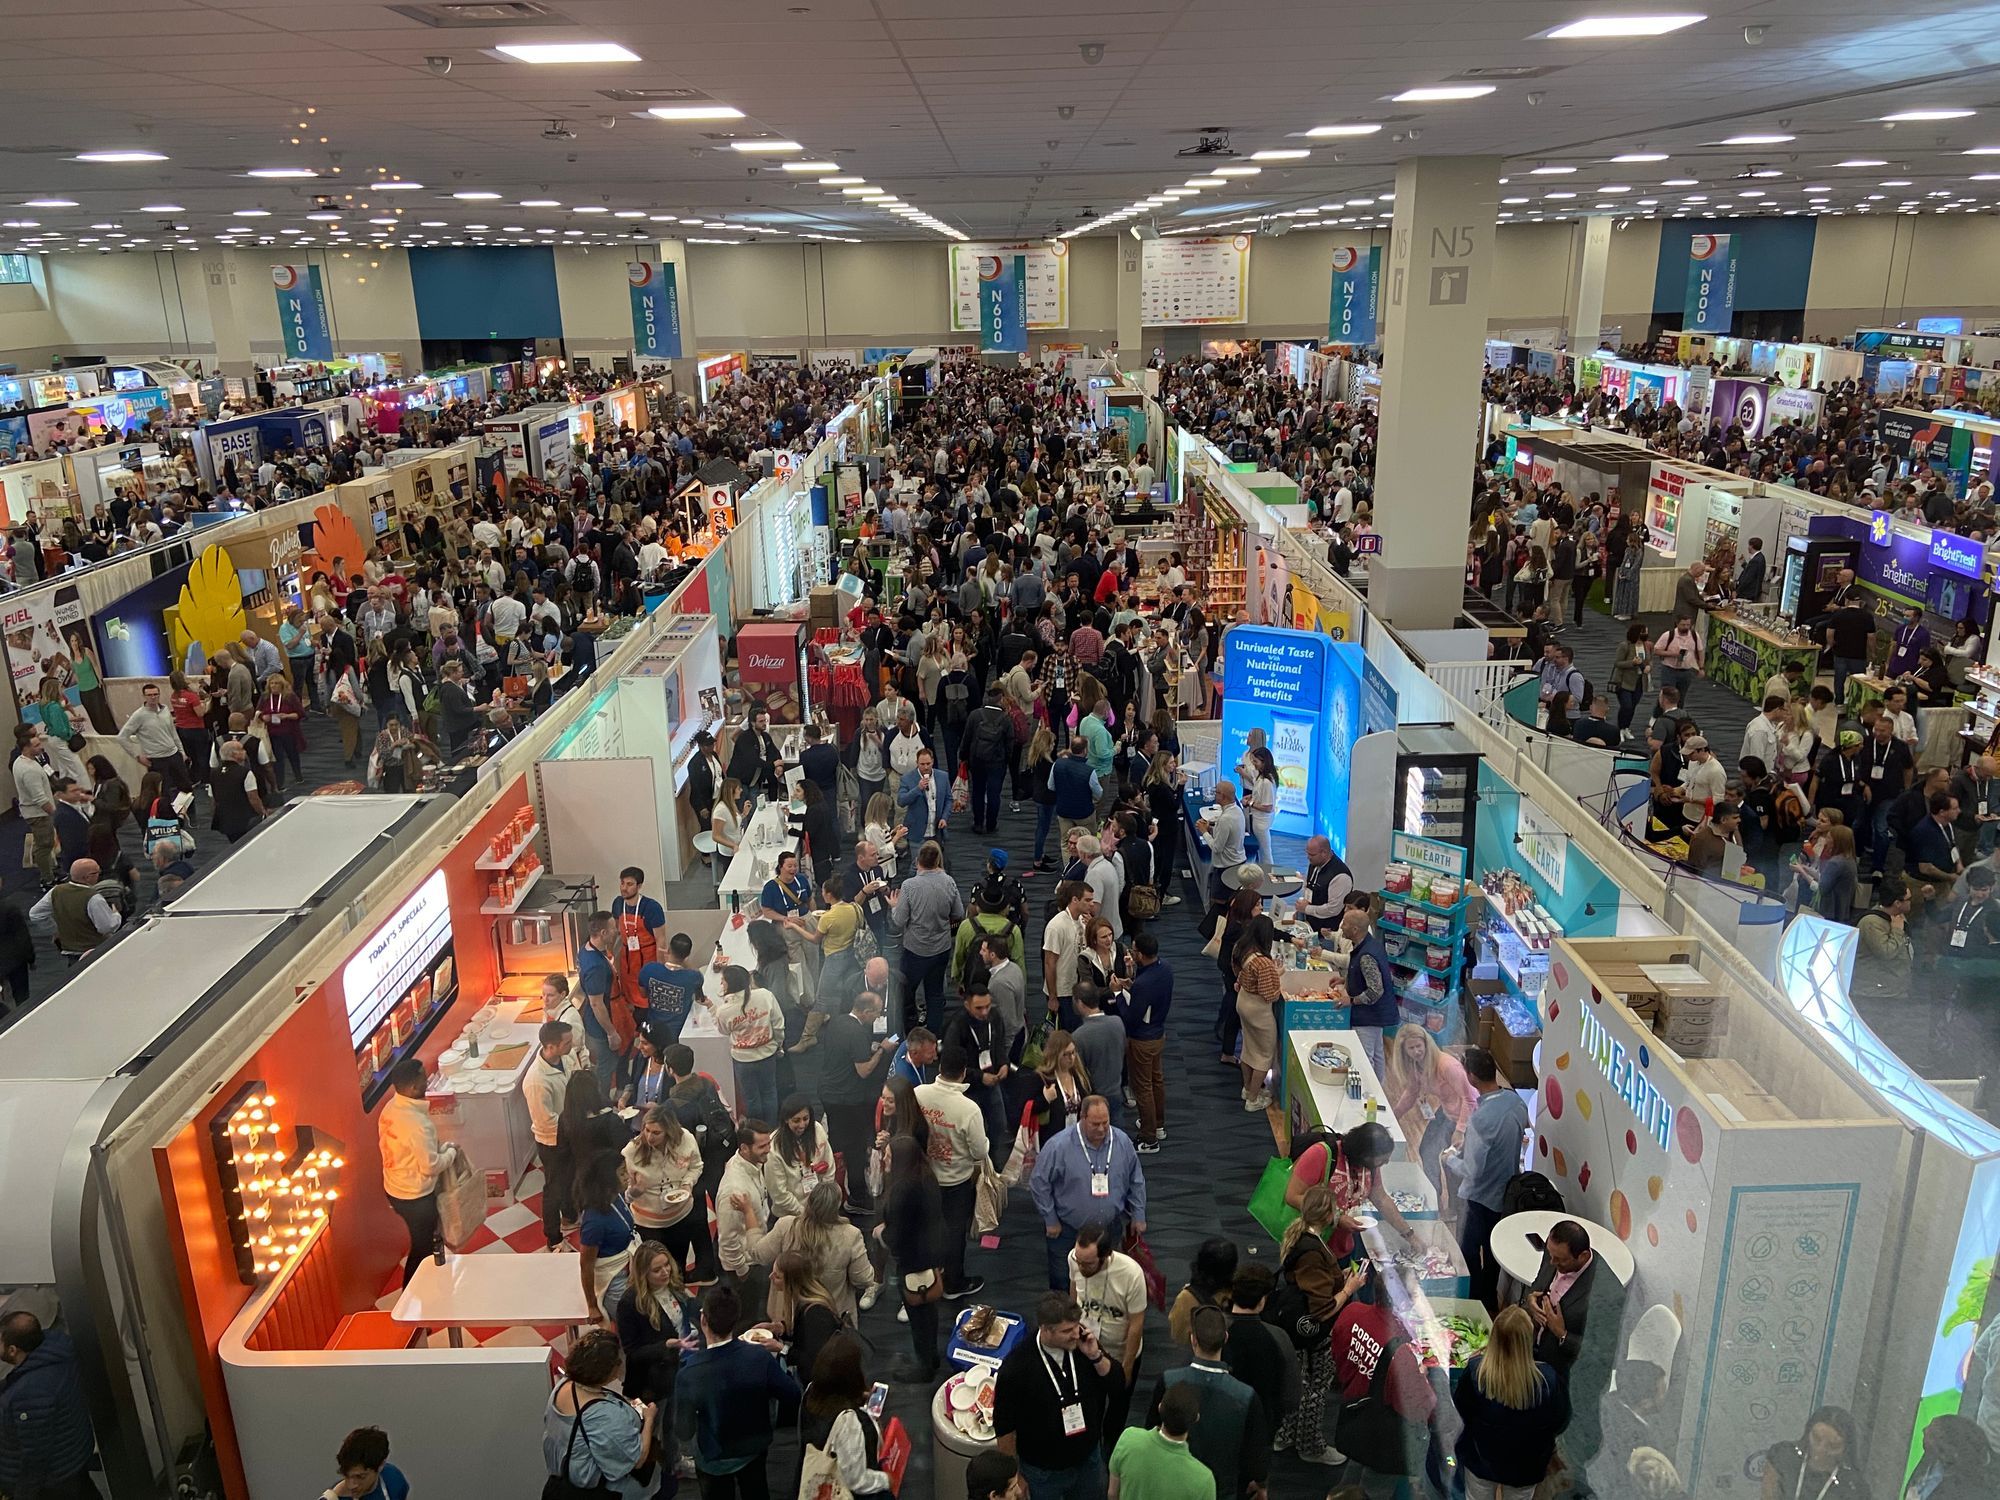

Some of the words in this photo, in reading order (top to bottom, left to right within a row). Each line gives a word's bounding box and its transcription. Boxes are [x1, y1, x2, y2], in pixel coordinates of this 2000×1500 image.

[1124, 249, 1138, 259] N6
[1430, 226, 1475, 258] N5
[668, 286, 676, 300] HOT
[1696, 269, 1713, 323] N800
[1725, 273, 1735, 308] PRODUCTS
[1341, 281, 1355, 335] N700
[1368, 287, 1377, 320] PRODUCTS
[289, 299, 307, 352] N400
[318, 304, 328, 338] PRODUCTS
[642, 296, 656, 349] N500
[670, 302, 678, 335] PRODUCTS
[992, 290, 1002, 343] N600
[105, 399, 125, 421] Fody
[134, 397, 157, 410] DAILY
[221, 432, 252, 452] BASE
[1898, 430, 1911, 440] COLD
[269, 529, 302, 569] Bubbies
[1932, 542, 1977, 568] BrightFresh
[5, 608, 32, 628] FUEL
[54, 603, 78, 616] WOMEN
[57, 611, 79, 624] OWNED
[748, 654, 786, 668] Delizza
[1235, 640, 1285, 656] Unrivaled
[1288, 647, 1315, 658] Taste
[1246, 659, 1302, 674] Nutritional
[1247, 675, 1300, 691] Functional
[1253, 687, 1293, 702] Benefits
[150, 826, 179, 836] WILDE
[1404, 843, 1451, 867] YUMEARTH
[369, 930, 397, 963] TODAY'S
[398, 897, 427, 933] SPECIALS
[1579, 998, 1673, 1153] YUMEARTH
[1350, 1336, 1365, 1357] FOR
[1364, 1351, 1378, 1369] TH
